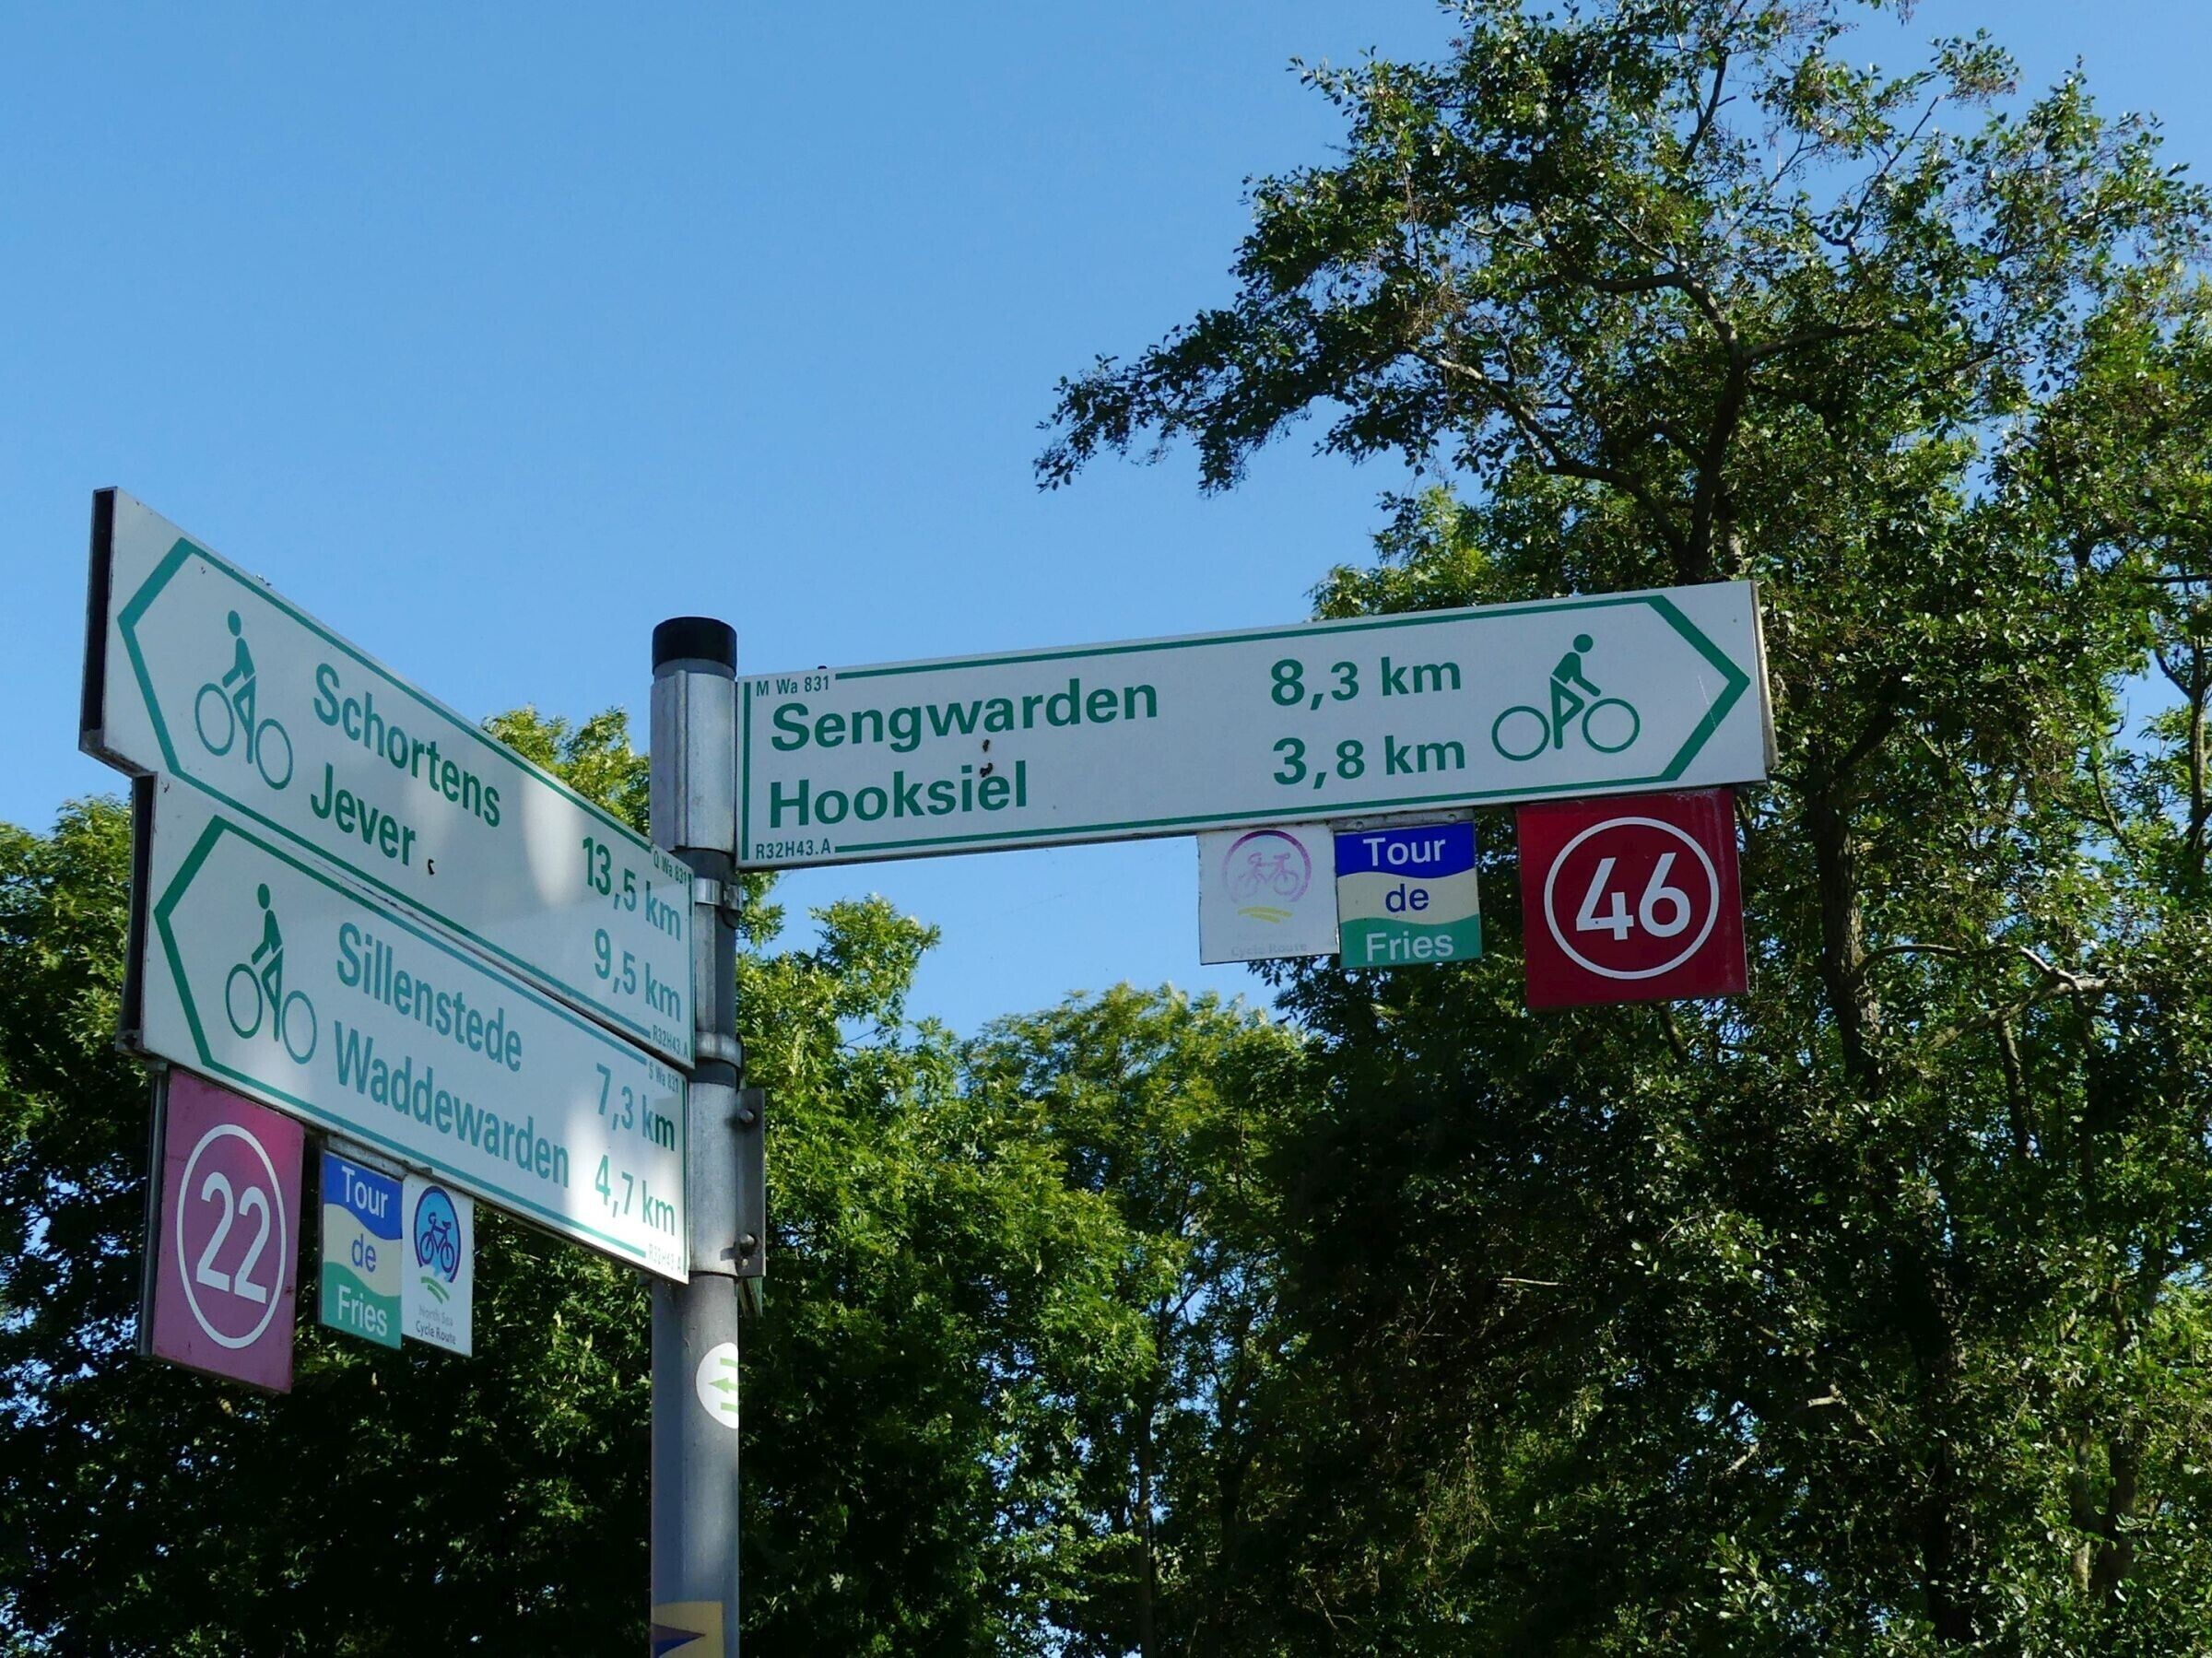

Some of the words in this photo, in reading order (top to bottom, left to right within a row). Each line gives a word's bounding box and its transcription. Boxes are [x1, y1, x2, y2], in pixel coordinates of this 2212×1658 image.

[756, 680, 769, 697] M
[776, 678, 797, 694] Wa
[805, 676, 829, 692] 831
[771, 678, 1158, 753] Sengwarden
[1270, 659, 1359, 710] 8,3
[1381, 656, 1462, 697] km
[313, 663, 500, 828] Schortens
[1273, 737, 1365, 789] 3,8
[1384, 735, 1465, 775] km
[311, 762, 416, 865] Jever
[770, 760, 1026, 828] Hooksiel
[662, 855, 673, 877] Wa
[756, 838, 830, 859] R32H43.A
[1363, 836, 1446, 867] Tour
[582, 837, 636, 911] 13,5
[646, 880, 680, 941] km
[1385, 883, 1430, 912] de
[1576, 852, 1691, 941] 46
[594, 928, 636, 995] 9,5
[645, 962, 680, 1022] km
[1366, 931, 1453, 962] Fries
[336, 922, 522, 1072] Sillenstede
[335, 1020, 570, 1188] Waddewarden
[596, 1062, 633, 1131] 7,3
[642, 1094, 675, 1151] km
[341, 1165, 388, 1218] Tour
[595, 1155, 633, 1217] 4,7
[642, 1180, 675, 1236] km
[195, 1171, 271, 1304] 22
[351, 1233, 377, 1273] de
[337, 1284, 387, 1336] Fries
